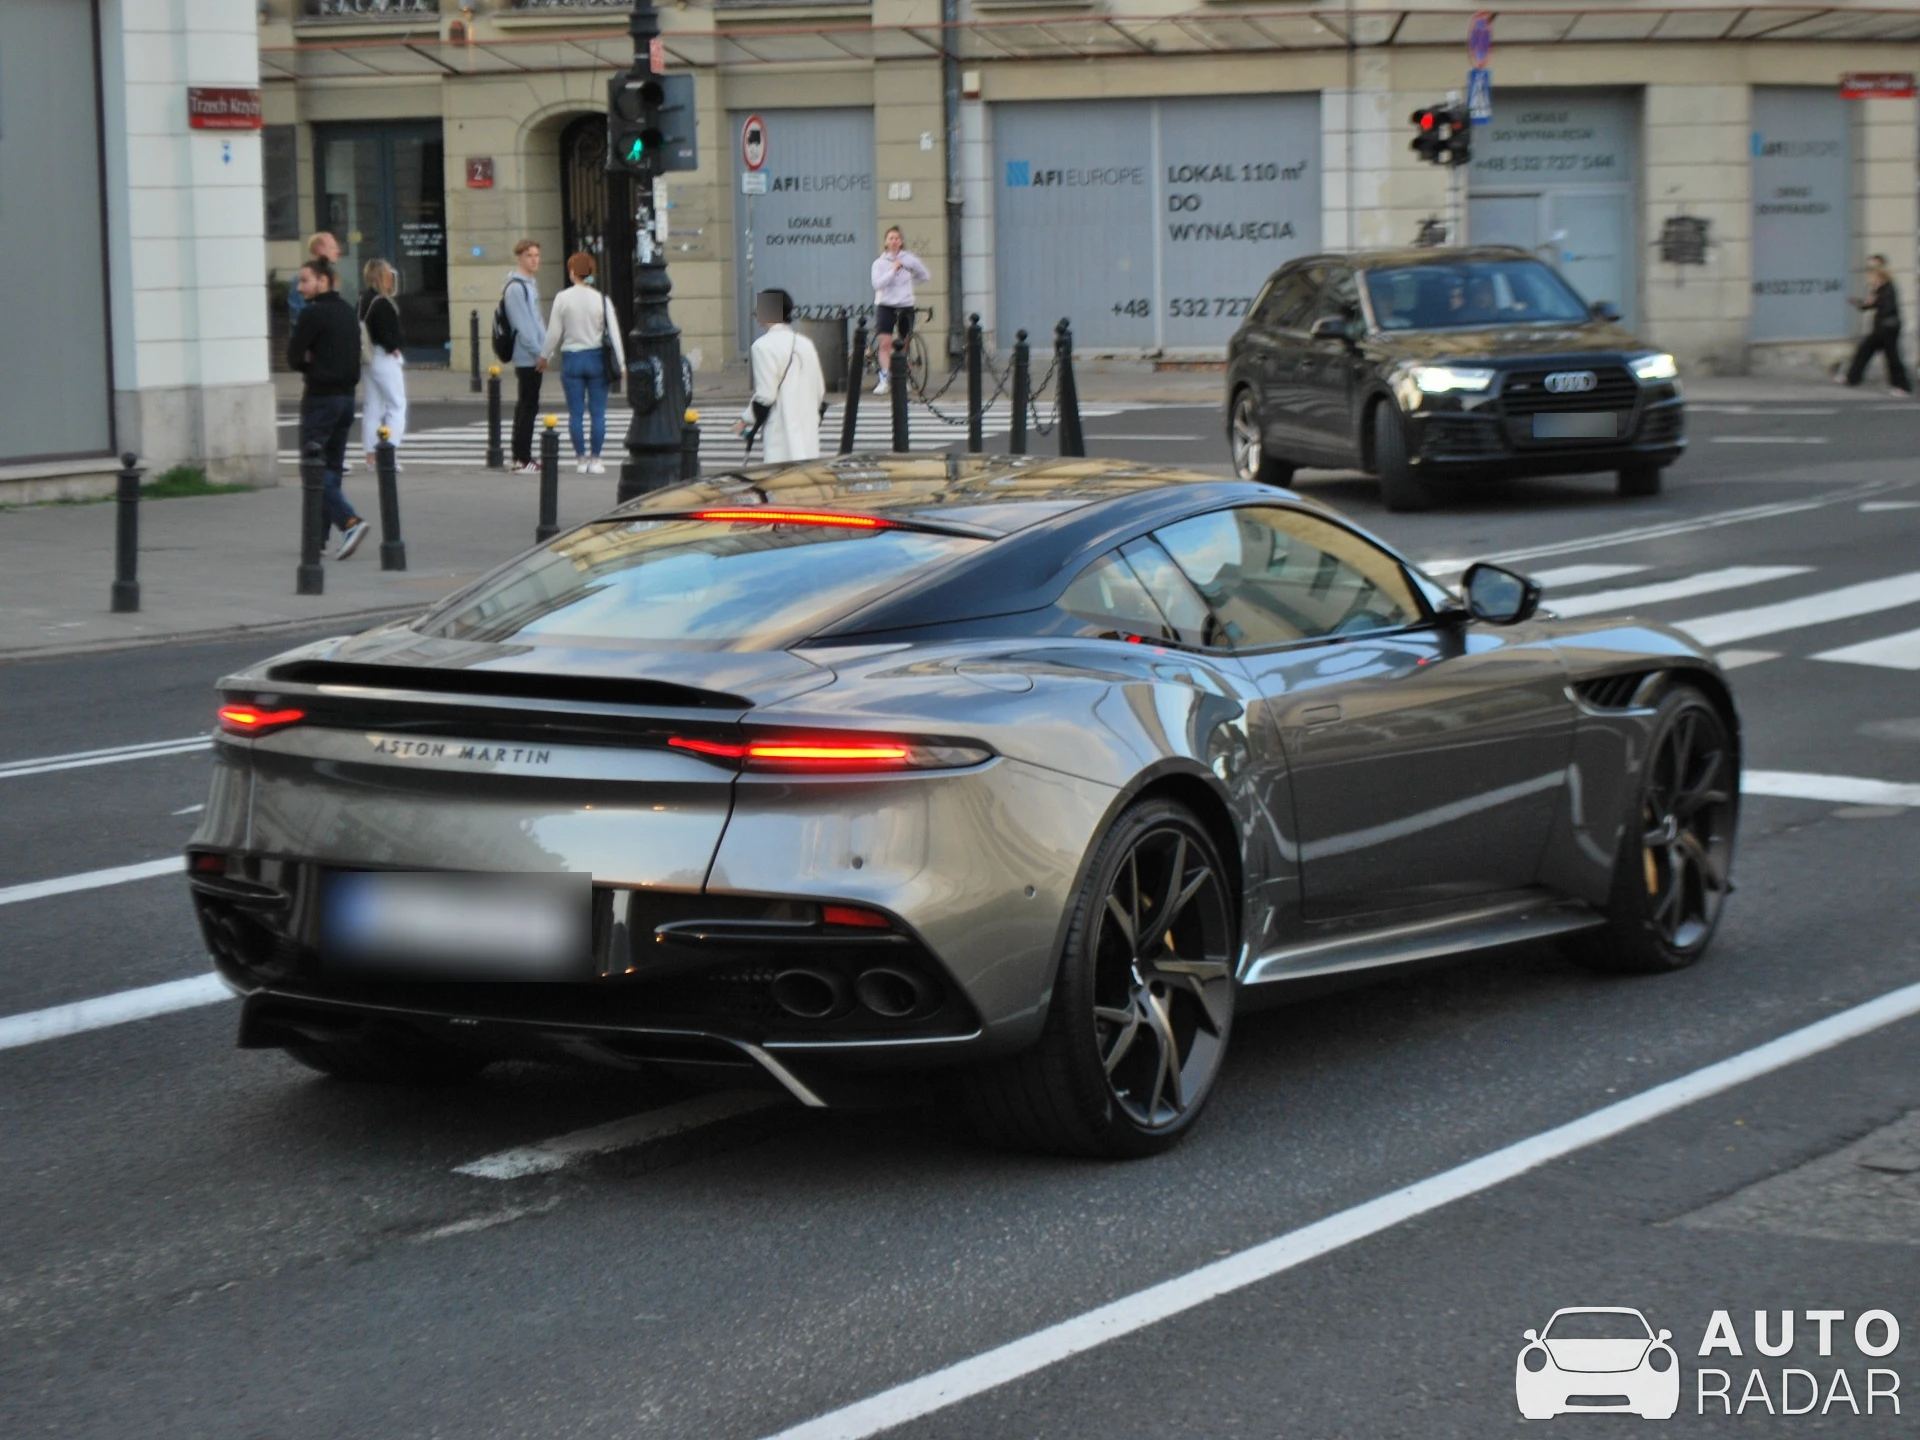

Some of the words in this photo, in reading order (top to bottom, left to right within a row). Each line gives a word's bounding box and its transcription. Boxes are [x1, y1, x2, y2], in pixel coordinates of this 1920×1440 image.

[191, 96, 227, 114] Trzech
[474, 164, 482, 181] 2
[1167, 164, 1236, 184] LOKAL
[1241, 162, 1278, 182] 110
[1168, 195, 1201, 212] DO
[788, 217, 833, 229] LOKALE
[766, 234, 784, 246] DO
[787, 233, 855, 246] WYNAJĘCIA
[1169, 222, 1294, 243] WYNAJĘCIA
[1111, 299, 1149, 318] +48
[1169, 299, 1207, 318] 532
[374, 739, 446, 758] ASTON
[458, 745, 551, 764] MARTIN
